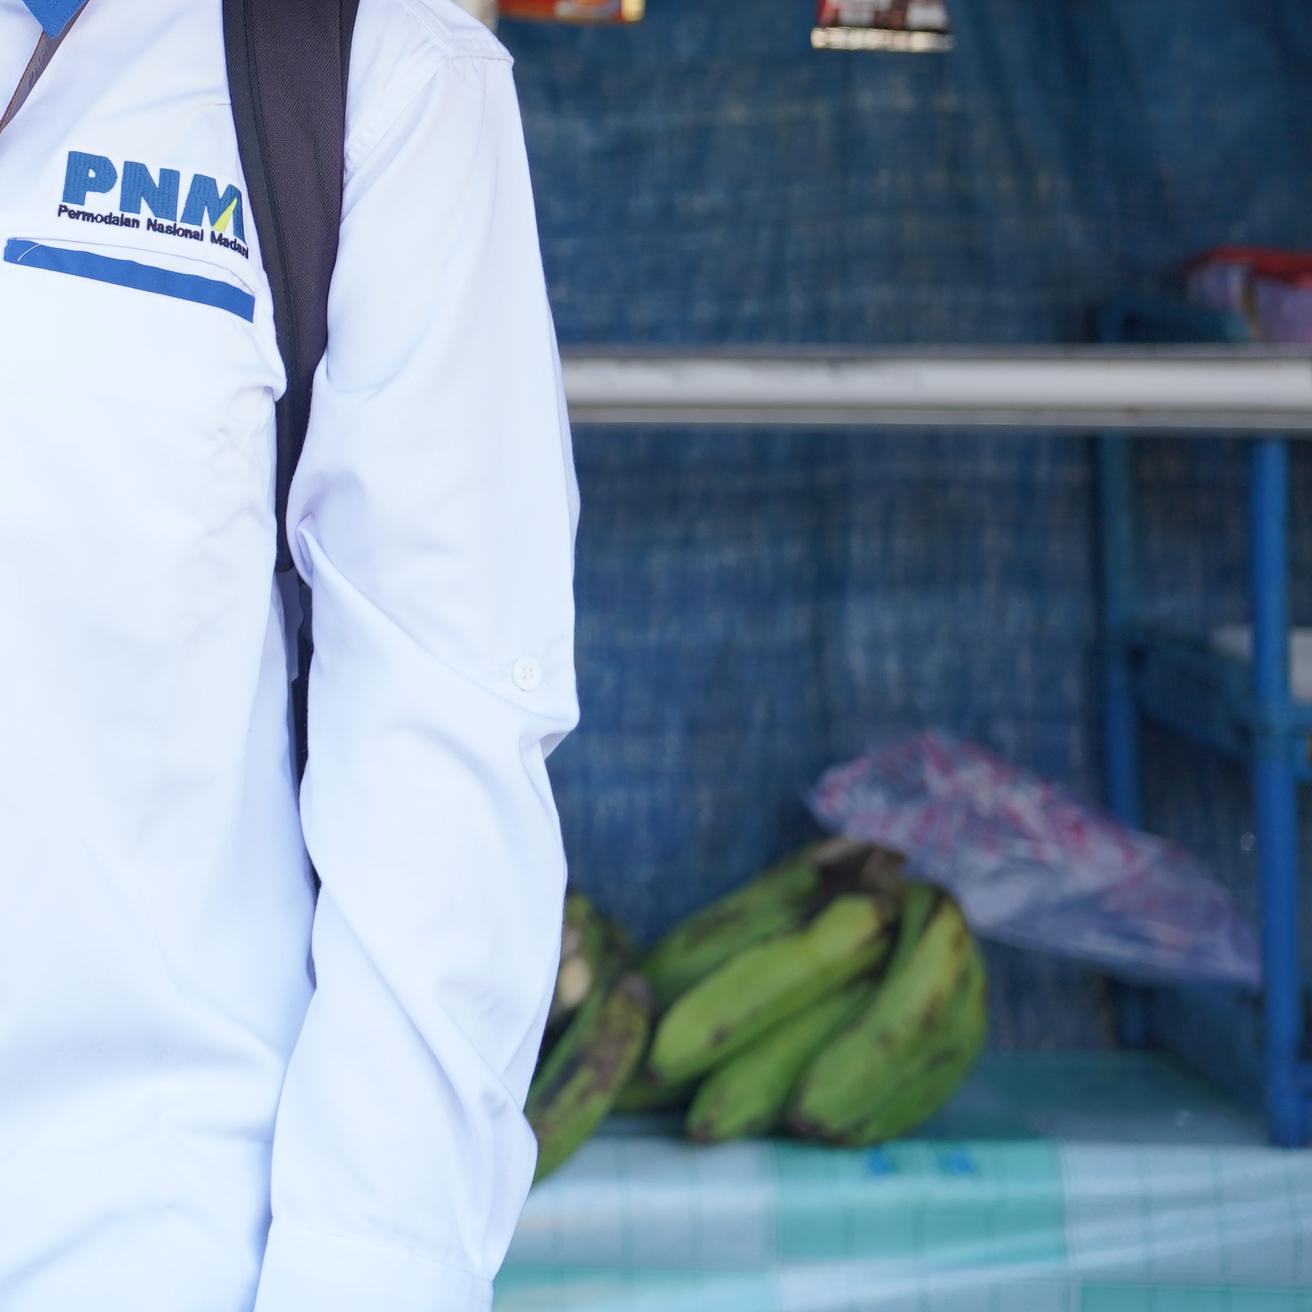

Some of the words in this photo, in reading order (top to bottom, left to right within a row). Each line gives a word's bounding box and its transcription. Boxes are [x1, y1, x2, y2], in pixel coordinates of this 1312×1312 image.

[57, 204, 140, 229] Permodalan
[146, 218, 204, 241] Nasional
[62, 151, 245, 243] PNM
